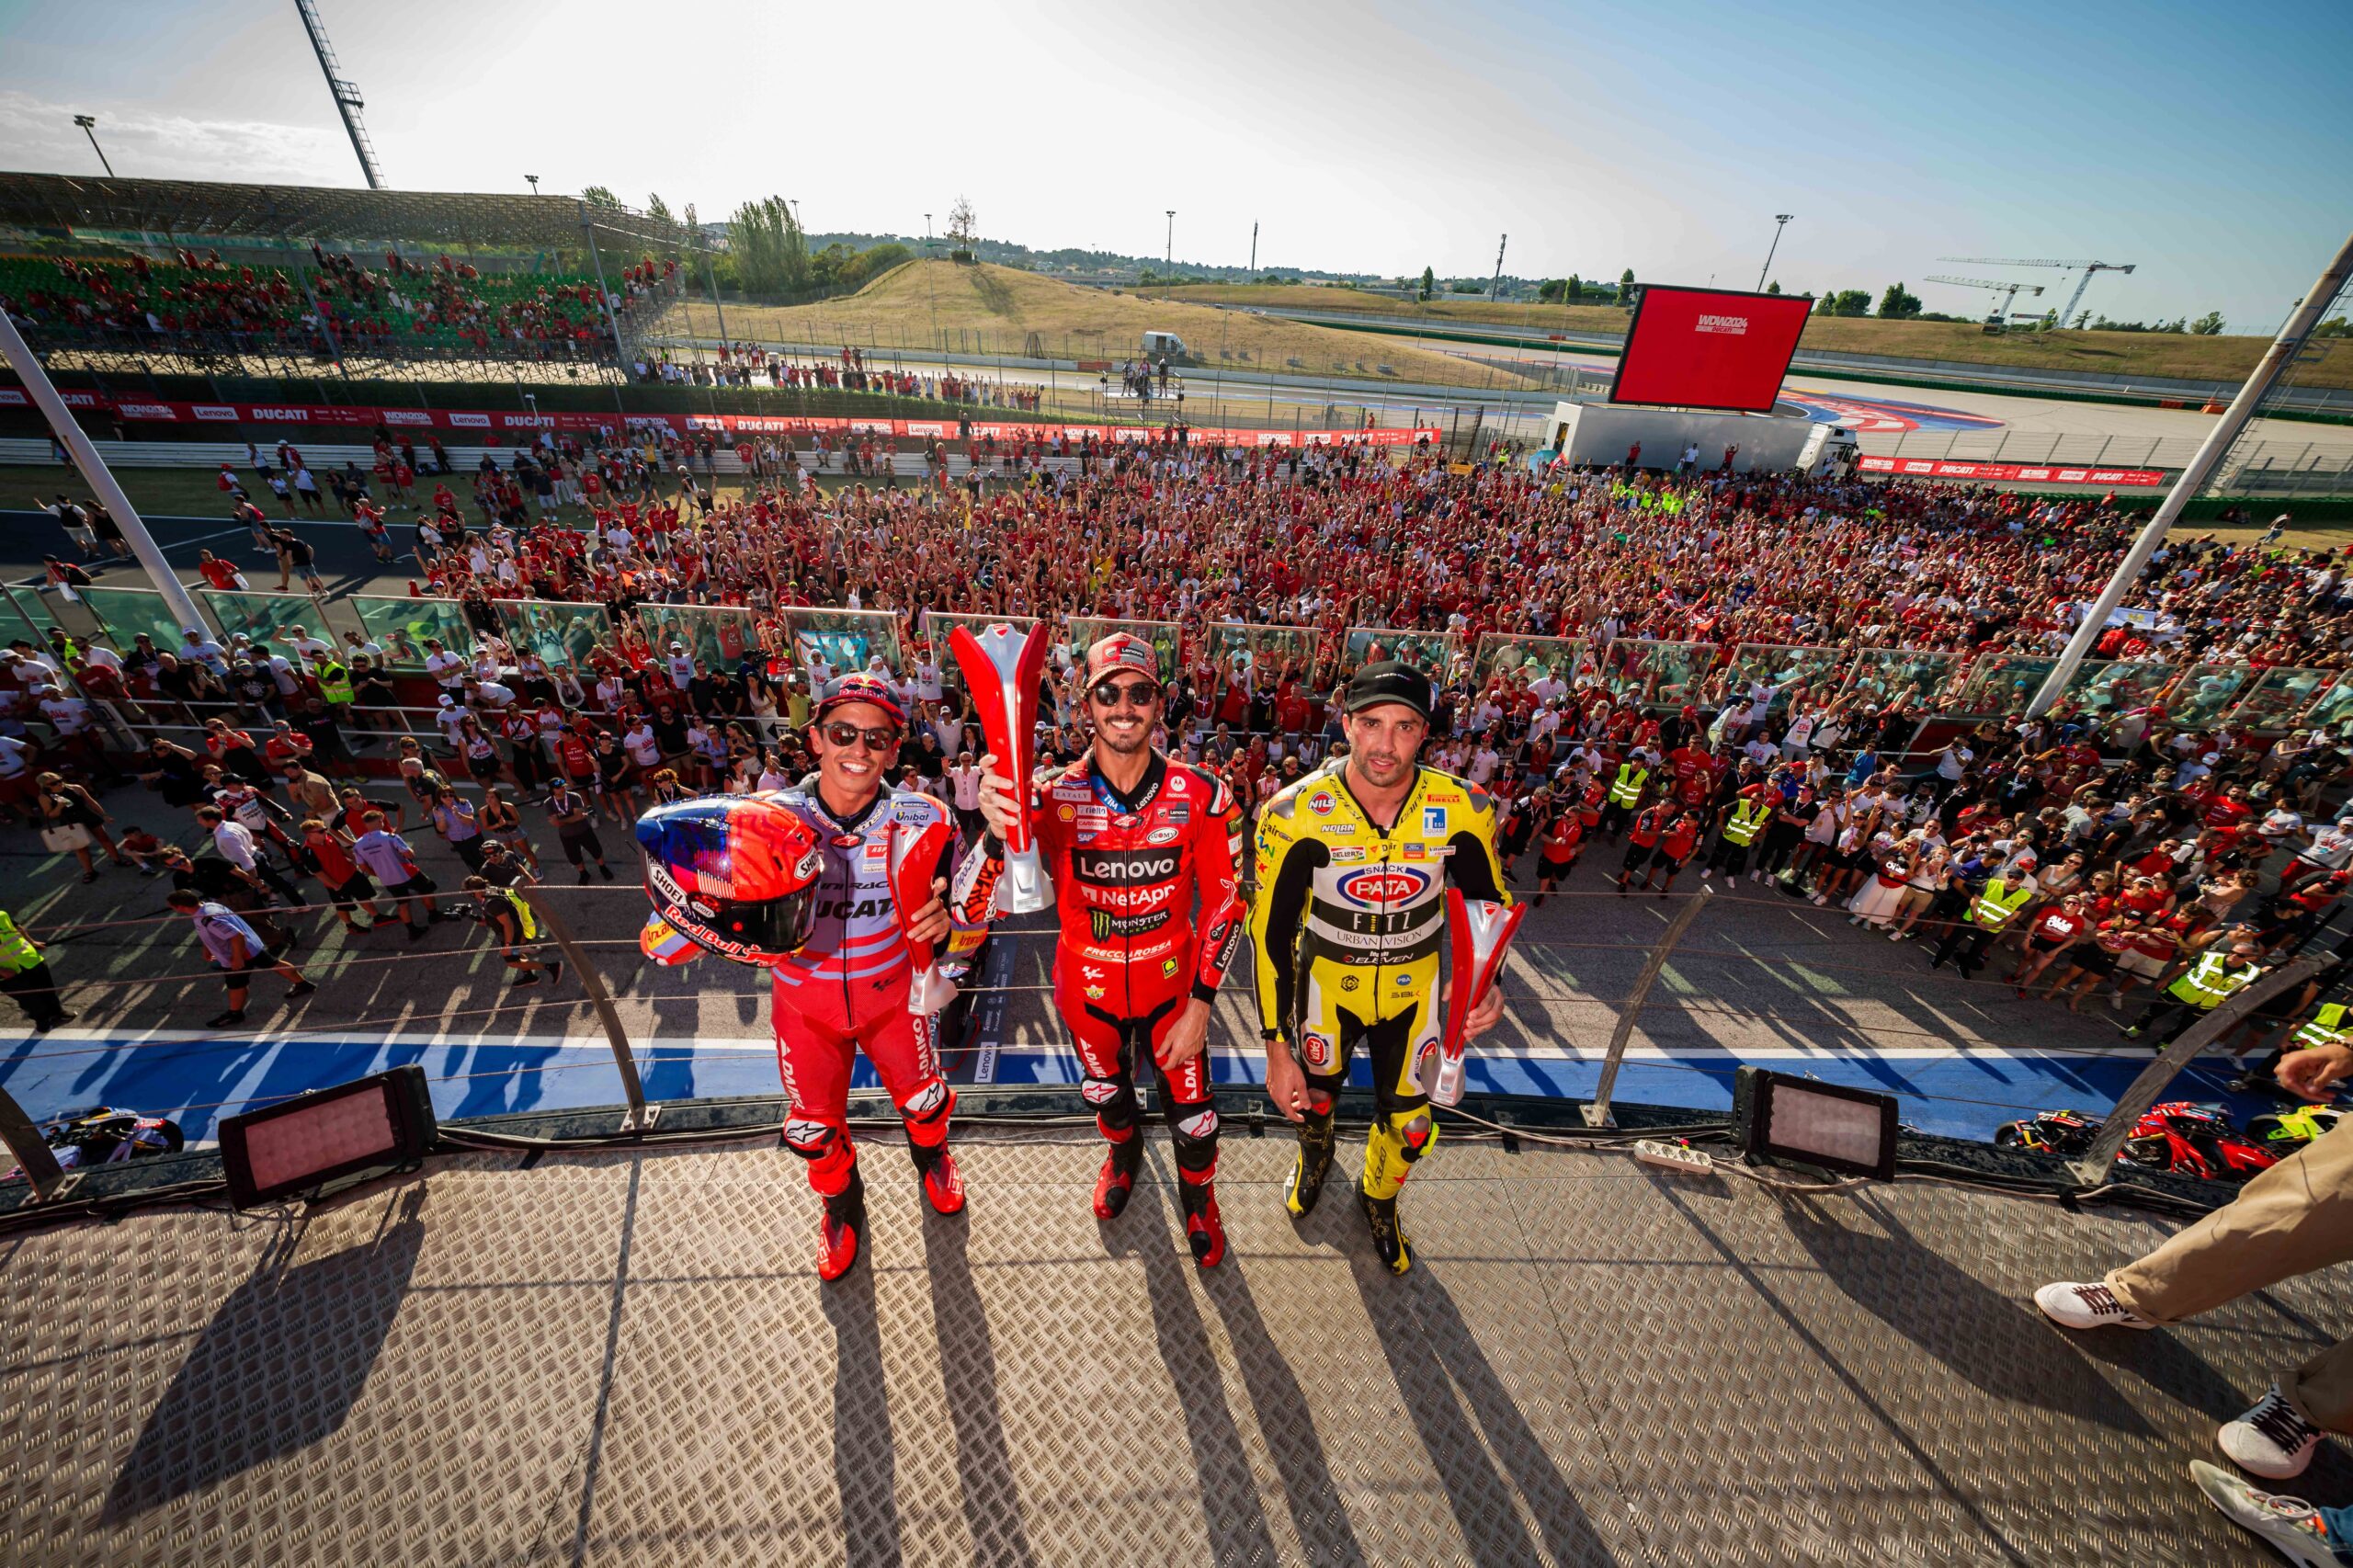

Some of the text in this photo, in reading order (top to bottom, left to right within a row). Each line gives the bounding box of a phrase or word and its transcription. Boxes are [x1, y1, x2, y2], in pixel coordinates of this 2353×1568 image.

[1699, 314, 1748, 328] WDW2024
[197, 408, 233, 417] Lenovo
[253, 409, 308, 420] DUCATI
[454, 416, 486, 425] Lenovo
[505, 416, 554, 426] DUCATI
[737, 421, 784, 431] DUCATI
[912, 426, 939, 435] Lenovo
[1939, 465, 1976, 474] DUCATI
[2091, 472, 2124, 481] DUCATI
[1121, 647, 1143, 656] Lenovo
[1055, 790, 1088, 799] EATALY
[1135, 782, 1159, 811] Lenovo
[1427, 794, 1460, 802] PIRELLI
[1104, 794, 1118, 810] TIM
[1309, 799, 1336, 809] NILS
[1086, 805, 1106, 814] riello
[896, 812, 929, 821] Unibat
[1322, 824, 1355, 834] NOLAN
[1077, 834, 1093, 842] SAP
[1151, 830, 1176, 839] SUOMY
[1081, 857, 1175, 879] Lenovo
[1365, 865, 1404, 874] SNACK
[654, 869, 683, 903] SHOEI
[1357, 880, 1411, 895] PATA
[695, 903, 712, 916] SHOEI
[1111, 911, 1167, 929] MONSTER
[665, 904, 701, 935] Red
[701, 928, 744, 954] Bull
[1120, 923, 1161, 933] ENERGY
[1337, 929, 1422, 946] URBAN VISION
[1085, 939, 1172, 959] FRECCIAROSSA
[1216, 924, 1240, 968] Lenovo
[913, 1017, 928, 1071] DAIKO
[1310, 1040, 1321, 1060] PATA
[978, 1045, 992, 1080] Lenovo
